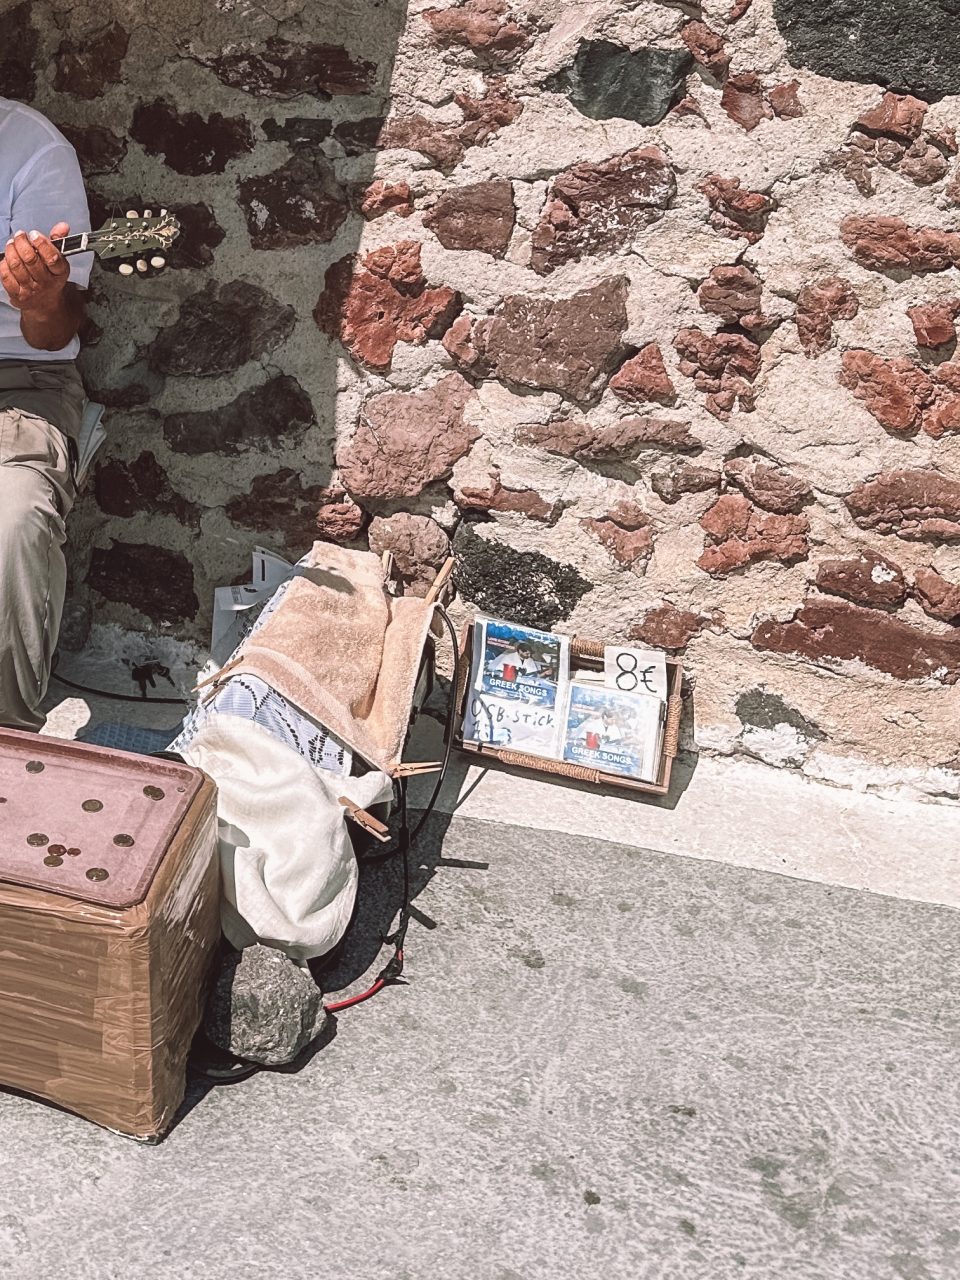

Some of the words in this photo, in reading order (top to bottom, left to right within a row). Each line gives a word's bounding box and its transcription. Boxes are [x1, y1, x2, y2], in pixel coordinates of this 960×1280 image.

[615, 652, 658, 693] 8€
[489, 678, 518, 691] GREEK
[518, 684, 548, 697] SONGS
[571, 746, 601, 759] GREEK
[602, 752, 632, 764] SONGS
